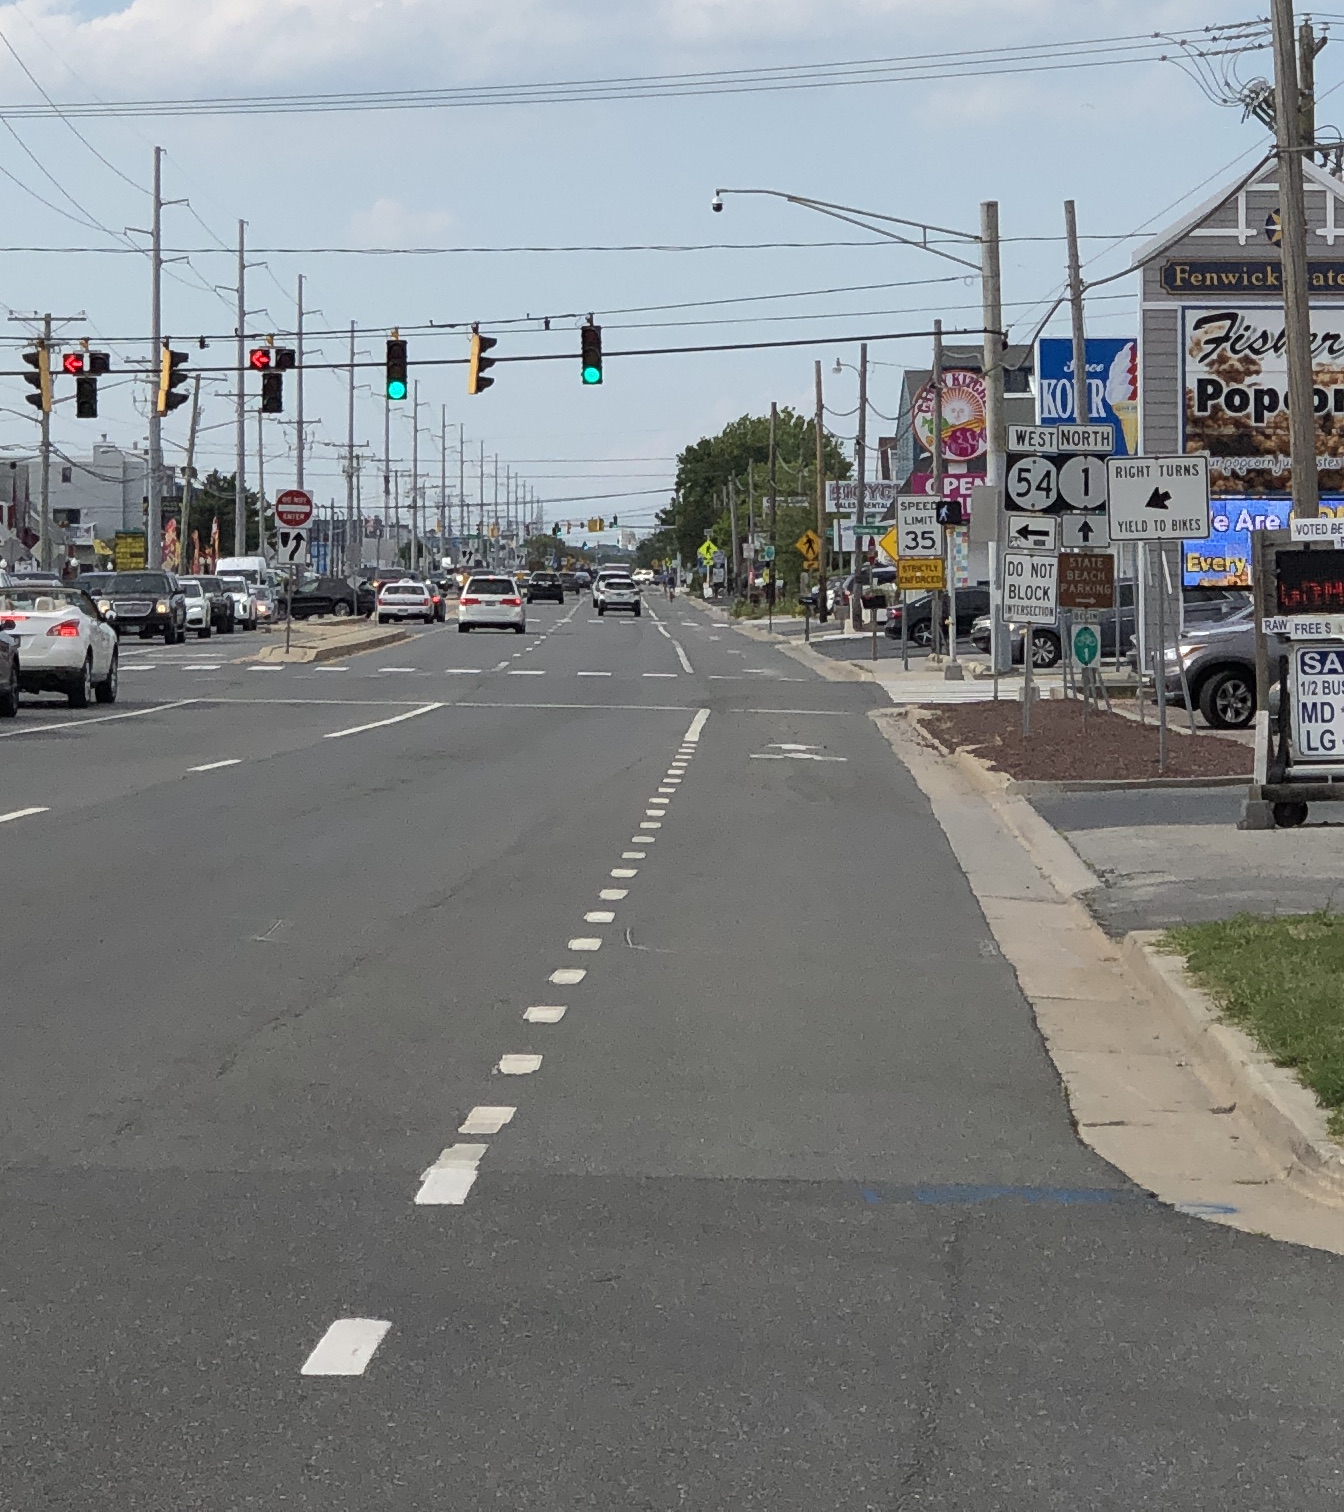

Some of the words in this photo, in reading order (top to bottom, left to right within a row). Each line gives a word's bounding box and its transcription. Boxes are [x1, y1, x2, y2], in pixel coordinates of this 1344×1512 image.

[1174, 265, 1280, 286] Fenwick
[1015, 429, 1056, 448] WEST
[1060, 429, 1111, 447] NORTH
[1115, 465, 1151, 479] RIGHT
[1158, 463, 1200, 478] TURNS
[1223, 456, 1274, 472] popcorn
[1015, 467, 1053, 500] 54
[1081, 466, 1090, 497] 1
[900, 501, 937, 511] SPEED
[904, 515, 934, 526] LIMIT
[1117, 519, 1148, 533] YIELD
[1153, 519, 1167, 532] TO
[1171, 518, 1202, 532] BIKES
[1235, 509, 1282, 532] Are
[1295, 523, 1328, 536] VOTED
[904, 530, 936, 551] 35
[1007, 561, 1024, 577] DO
[1030, 562, 1055, 579] NOT
[1069, 557, 1104, 568] STATE
[1186, 552, 1247, 575] Every
[1066, 570, 1106, 581] BEACH
[1008, 583, 1051, 602] BLOCK
[1060, 583, 1112, 595] PARKING
[1004, 603, 1054, 617] INTERSECTION
[1264, 618, 1288, 631] RAW
[1294, 622, 1322, 635] FREE
[1300, 680, 1318, 696] 1/2
[1300, 701, 1335, 724] MD
[1305, 729, 1337, 752] LG
